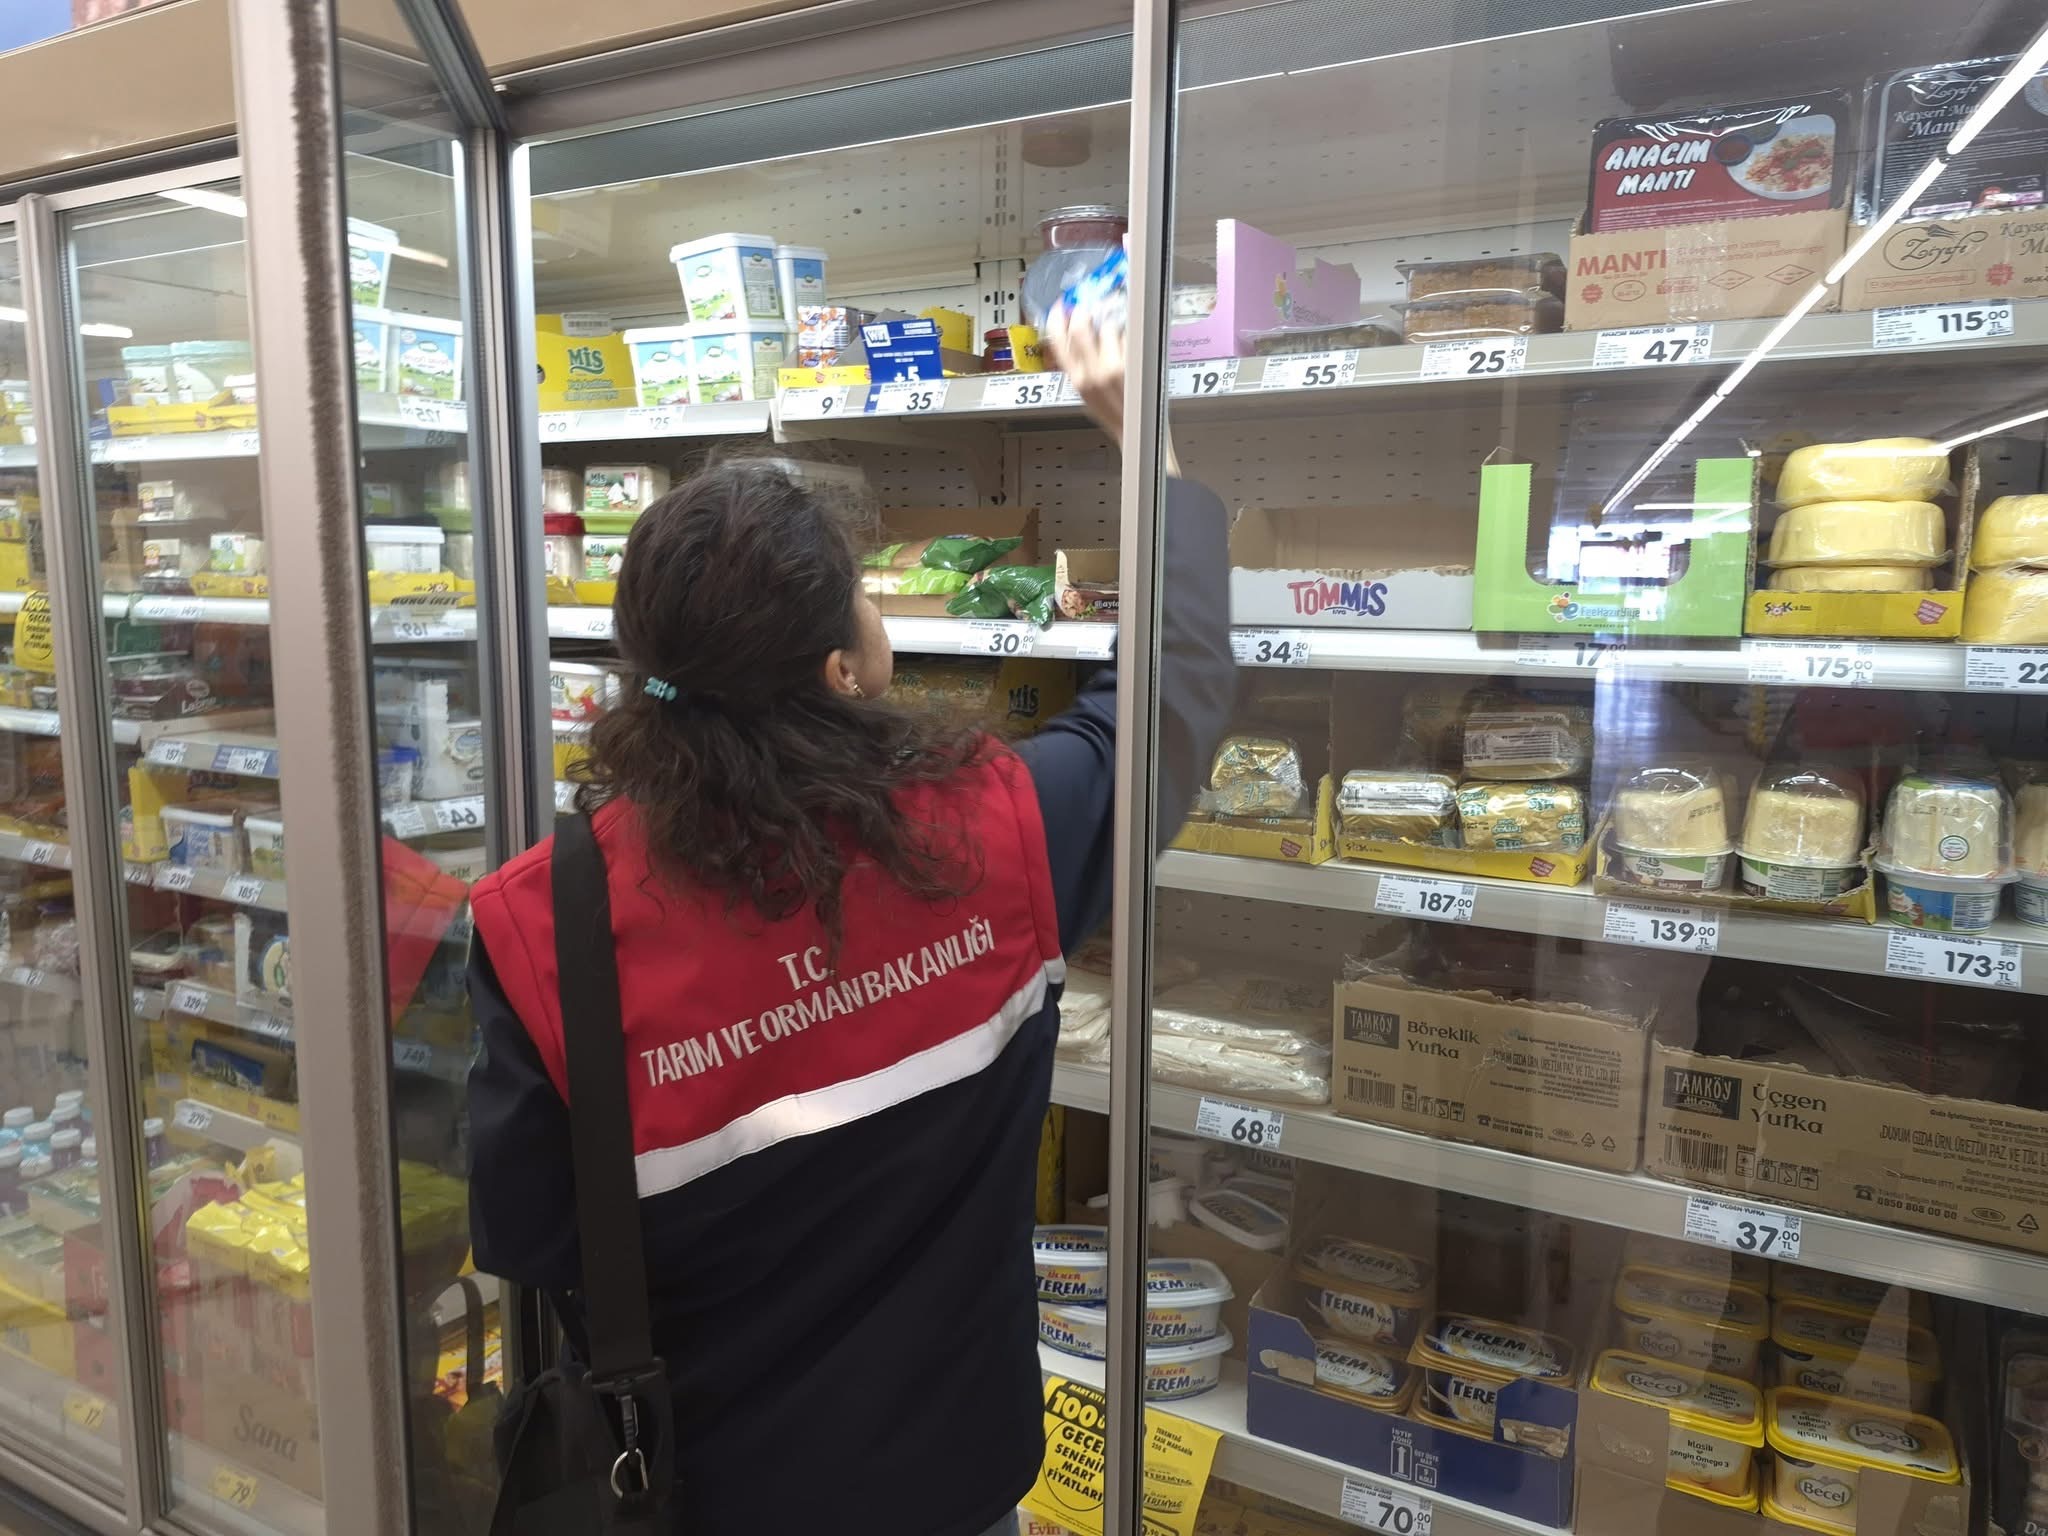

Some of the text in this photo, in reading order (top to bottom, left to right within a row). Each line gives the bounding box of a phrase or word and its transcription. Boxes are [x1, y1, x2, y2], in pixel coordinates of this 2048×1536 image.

[1604, 139, 1712, 171] ANACIM
[1616, 168, 1696, 196] MANTI
[1576, 249, 1668, 277] MANTI
[640, 914, 996, 1087] TARIM VE ORMAN BAKANLIĞI
[1407, 1020, 1481, 1045] Böreklik
[1407, 1039, 1460, 1059] Yufka
[1673, 1072, 1732, 1100] TAMKÖY
[1752, 1083, 1828, 1113] Üçgen
[1751, 1108, 1825, 1135] Yufka
[1325, 1292, 1375, 1319] TEREM
[1040, 1323, 1075, 1345] EREM
[1146, 1322, 1187, 1338] EREM
[1447, 1325, 1527, 1353] TEREM
[1146, 1375, 1190, 1393] EREM
[1452, 1378, 1497, 1405] TERE
[1803, 1374, 1842, 1394] Becel
[1052, 1390, 1099, 1429] 100
[233, 1402, 300, 1463] Sana
[1061, 1460, 1097, 1482] MART
[1802, 1480, 1847, 1504] Becel
